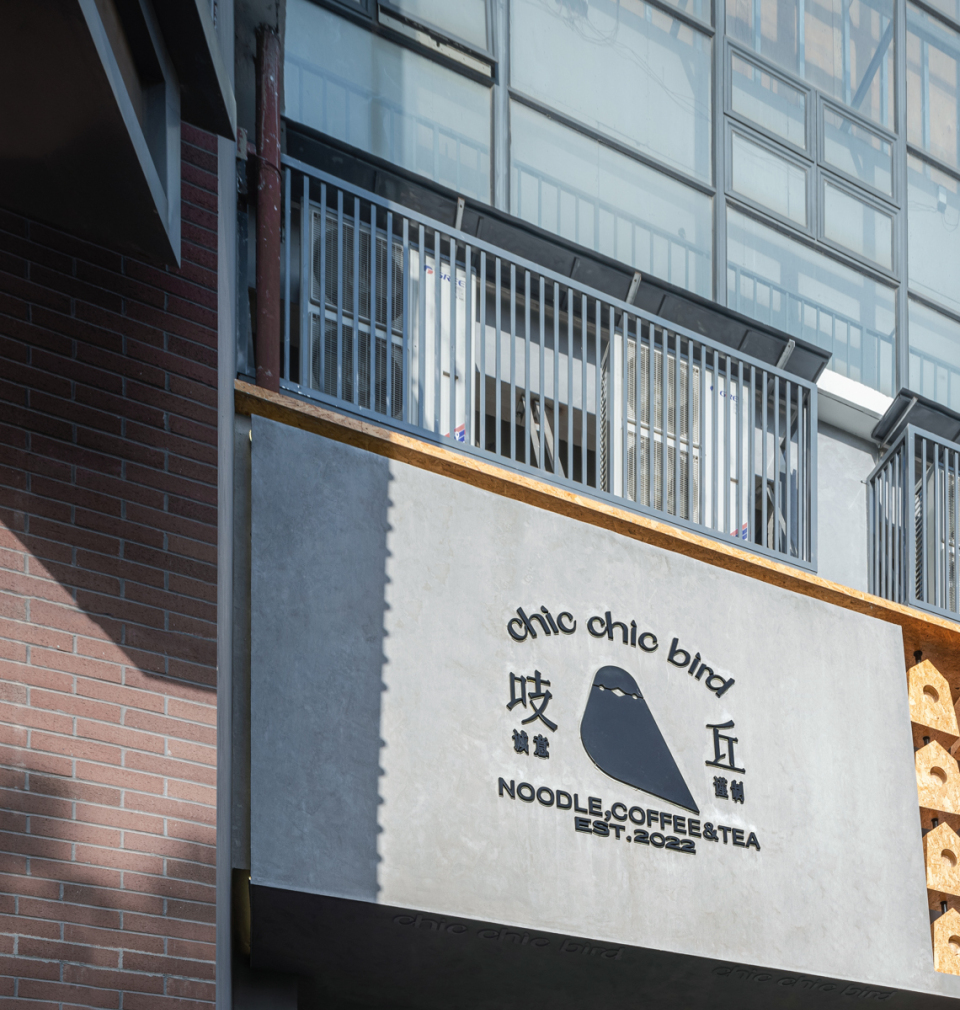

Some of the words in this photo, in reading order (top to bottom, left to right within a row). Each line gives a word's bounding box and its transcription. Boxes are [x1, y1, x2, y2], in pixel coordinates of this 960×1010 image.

[507, 605, 577, 642] chic
[587, 611, 659, 653] chic
[667, 637, 736, 698] bird
[506, 670, 558, 732] 吱
[574, 816, 697, 855] EST.2022
[393, 914, 468, 934] chic
[477, 927, 550, 946] chic
[560, 938, 625, 960] bird
[711, 965, 773, 983] chic
[777, 975, 837, 992] chic
